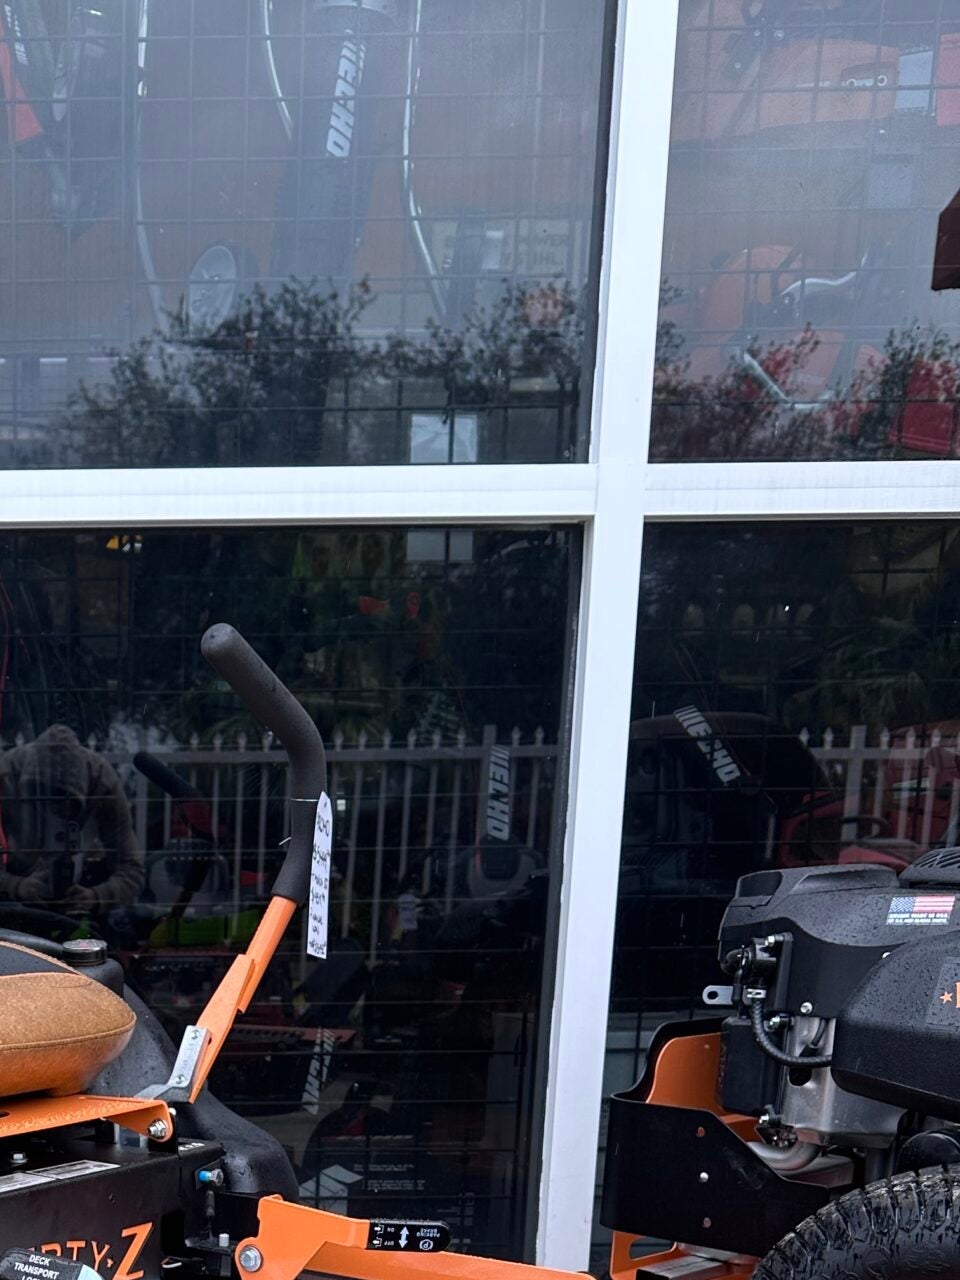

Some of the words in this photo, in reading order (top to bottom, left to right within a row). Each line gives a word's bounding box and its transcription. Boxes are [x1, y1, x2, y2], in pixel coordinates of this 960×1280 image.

[326, 57, 365, 157] ECHO
[687, 722, 741, 782] ECHO
[487, 762, 510, 841] ECHO
[14, 1262, 60, 1280] TRANSPORT
[29, 1254, 51, 1266] DECK
